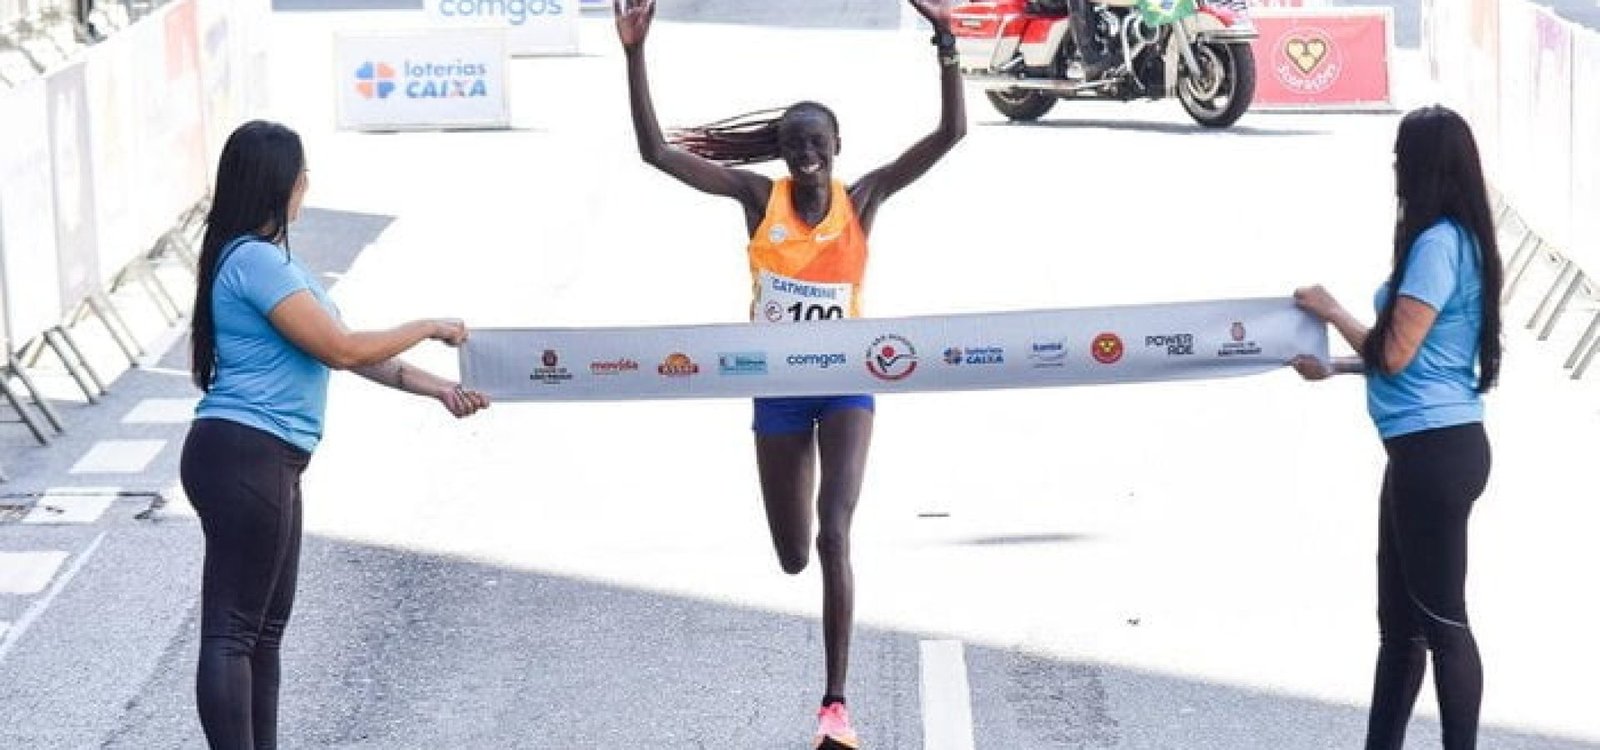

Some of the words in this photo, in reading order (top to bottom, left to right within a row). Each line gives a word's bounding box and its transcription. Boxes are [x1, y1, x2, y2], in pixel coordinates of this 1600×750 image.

[404, 60, 487, 78] loterias
[406, 80, 488, 99] CAIXA
[772, 278, 836, 299] CATHERINE
[787, 301, 844, 321] 100
[1145, 333, 1194, 347] POWER
[966, 355, 1004, 365] CAIXA
